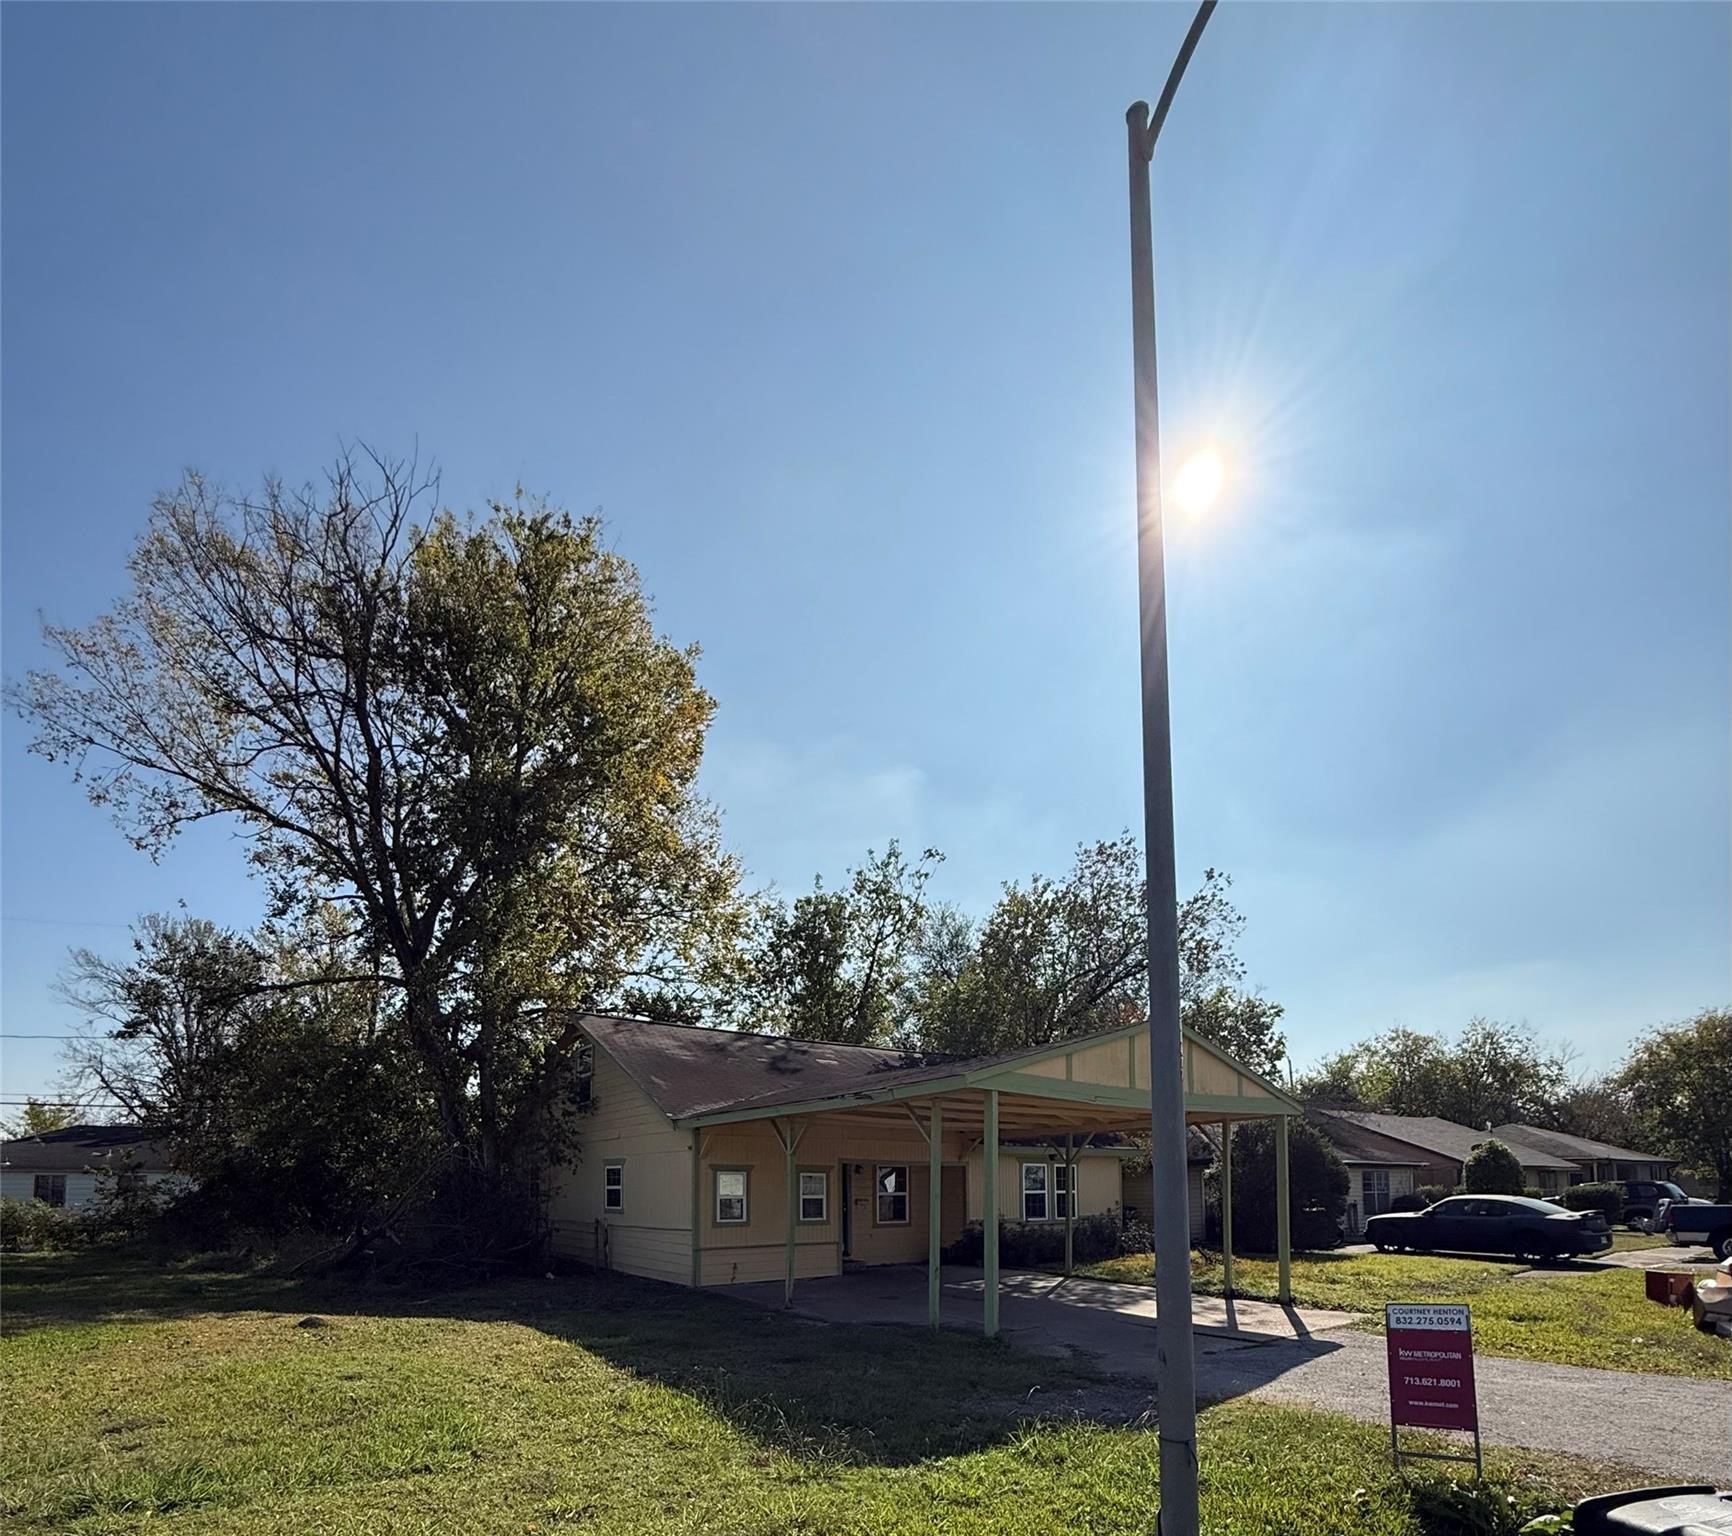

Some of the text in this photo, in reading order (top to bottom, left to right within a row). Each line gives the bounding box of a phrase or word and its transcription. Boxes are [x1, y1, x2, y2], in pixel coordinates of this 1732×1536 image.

[1395, 1316, 1462, 1325] 832.275.0594
[1413, 1350, 1462, 1359] METROPOLITAN
[1404, 1376, 1461, 1388] 713.621.8001
